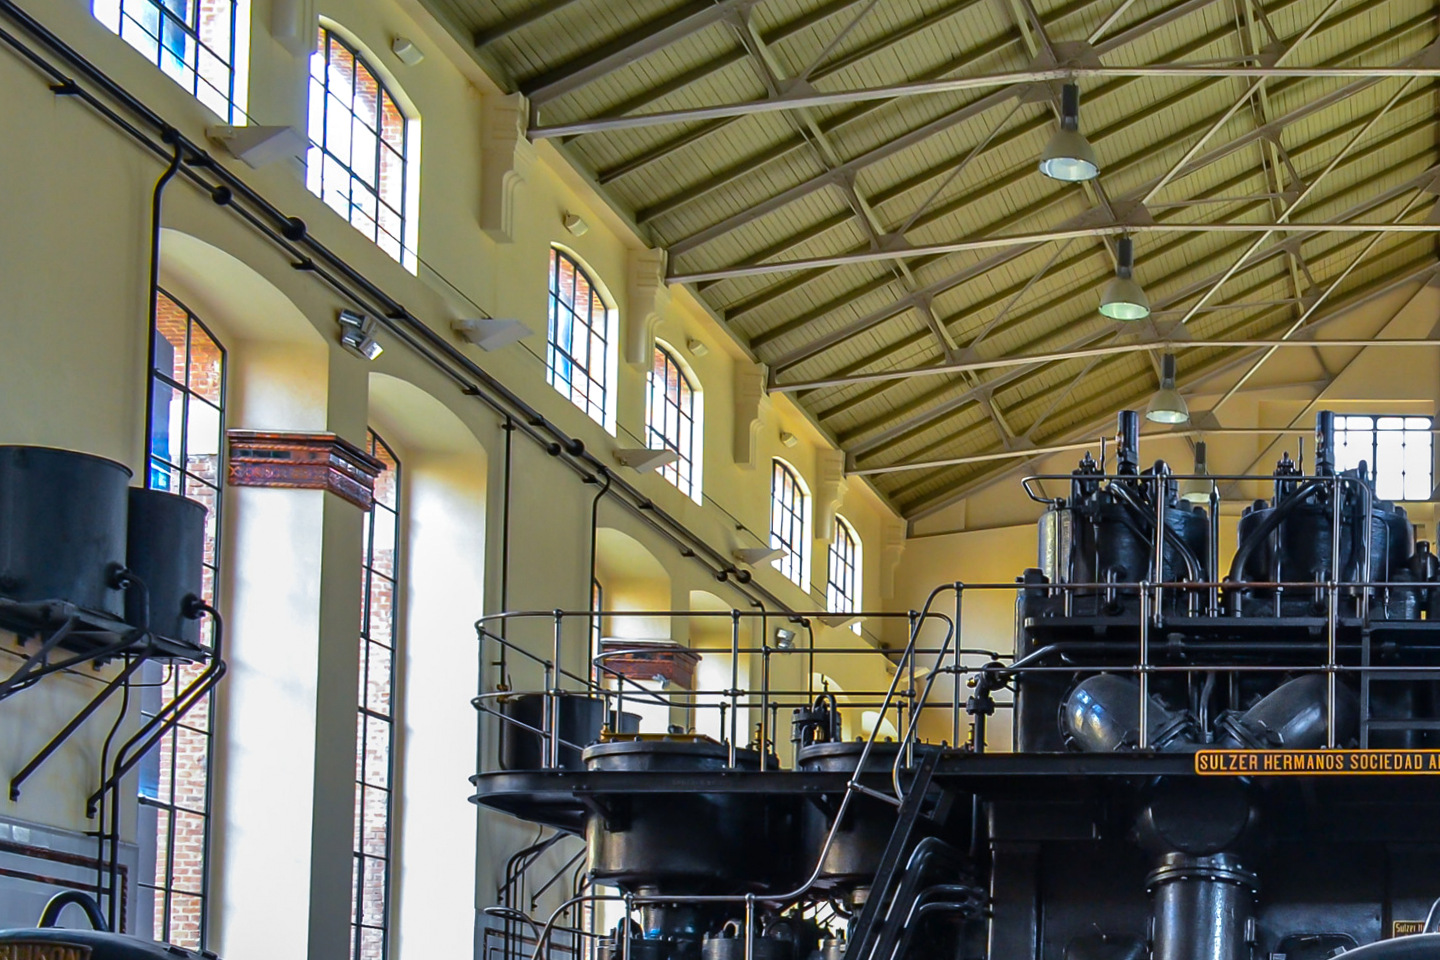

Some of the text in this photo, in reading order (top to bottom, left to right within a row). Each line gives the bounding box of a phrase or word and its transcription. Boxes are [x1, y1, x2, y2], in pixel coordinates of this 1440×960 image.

[1199, 753, 1258, 770] SULZER
[1263, 753, 1344, 770] HERMANOS
[1350, 753, 1423, 770] SOCIEDAD
[1395, 923, 1416, 933] Sulzer
